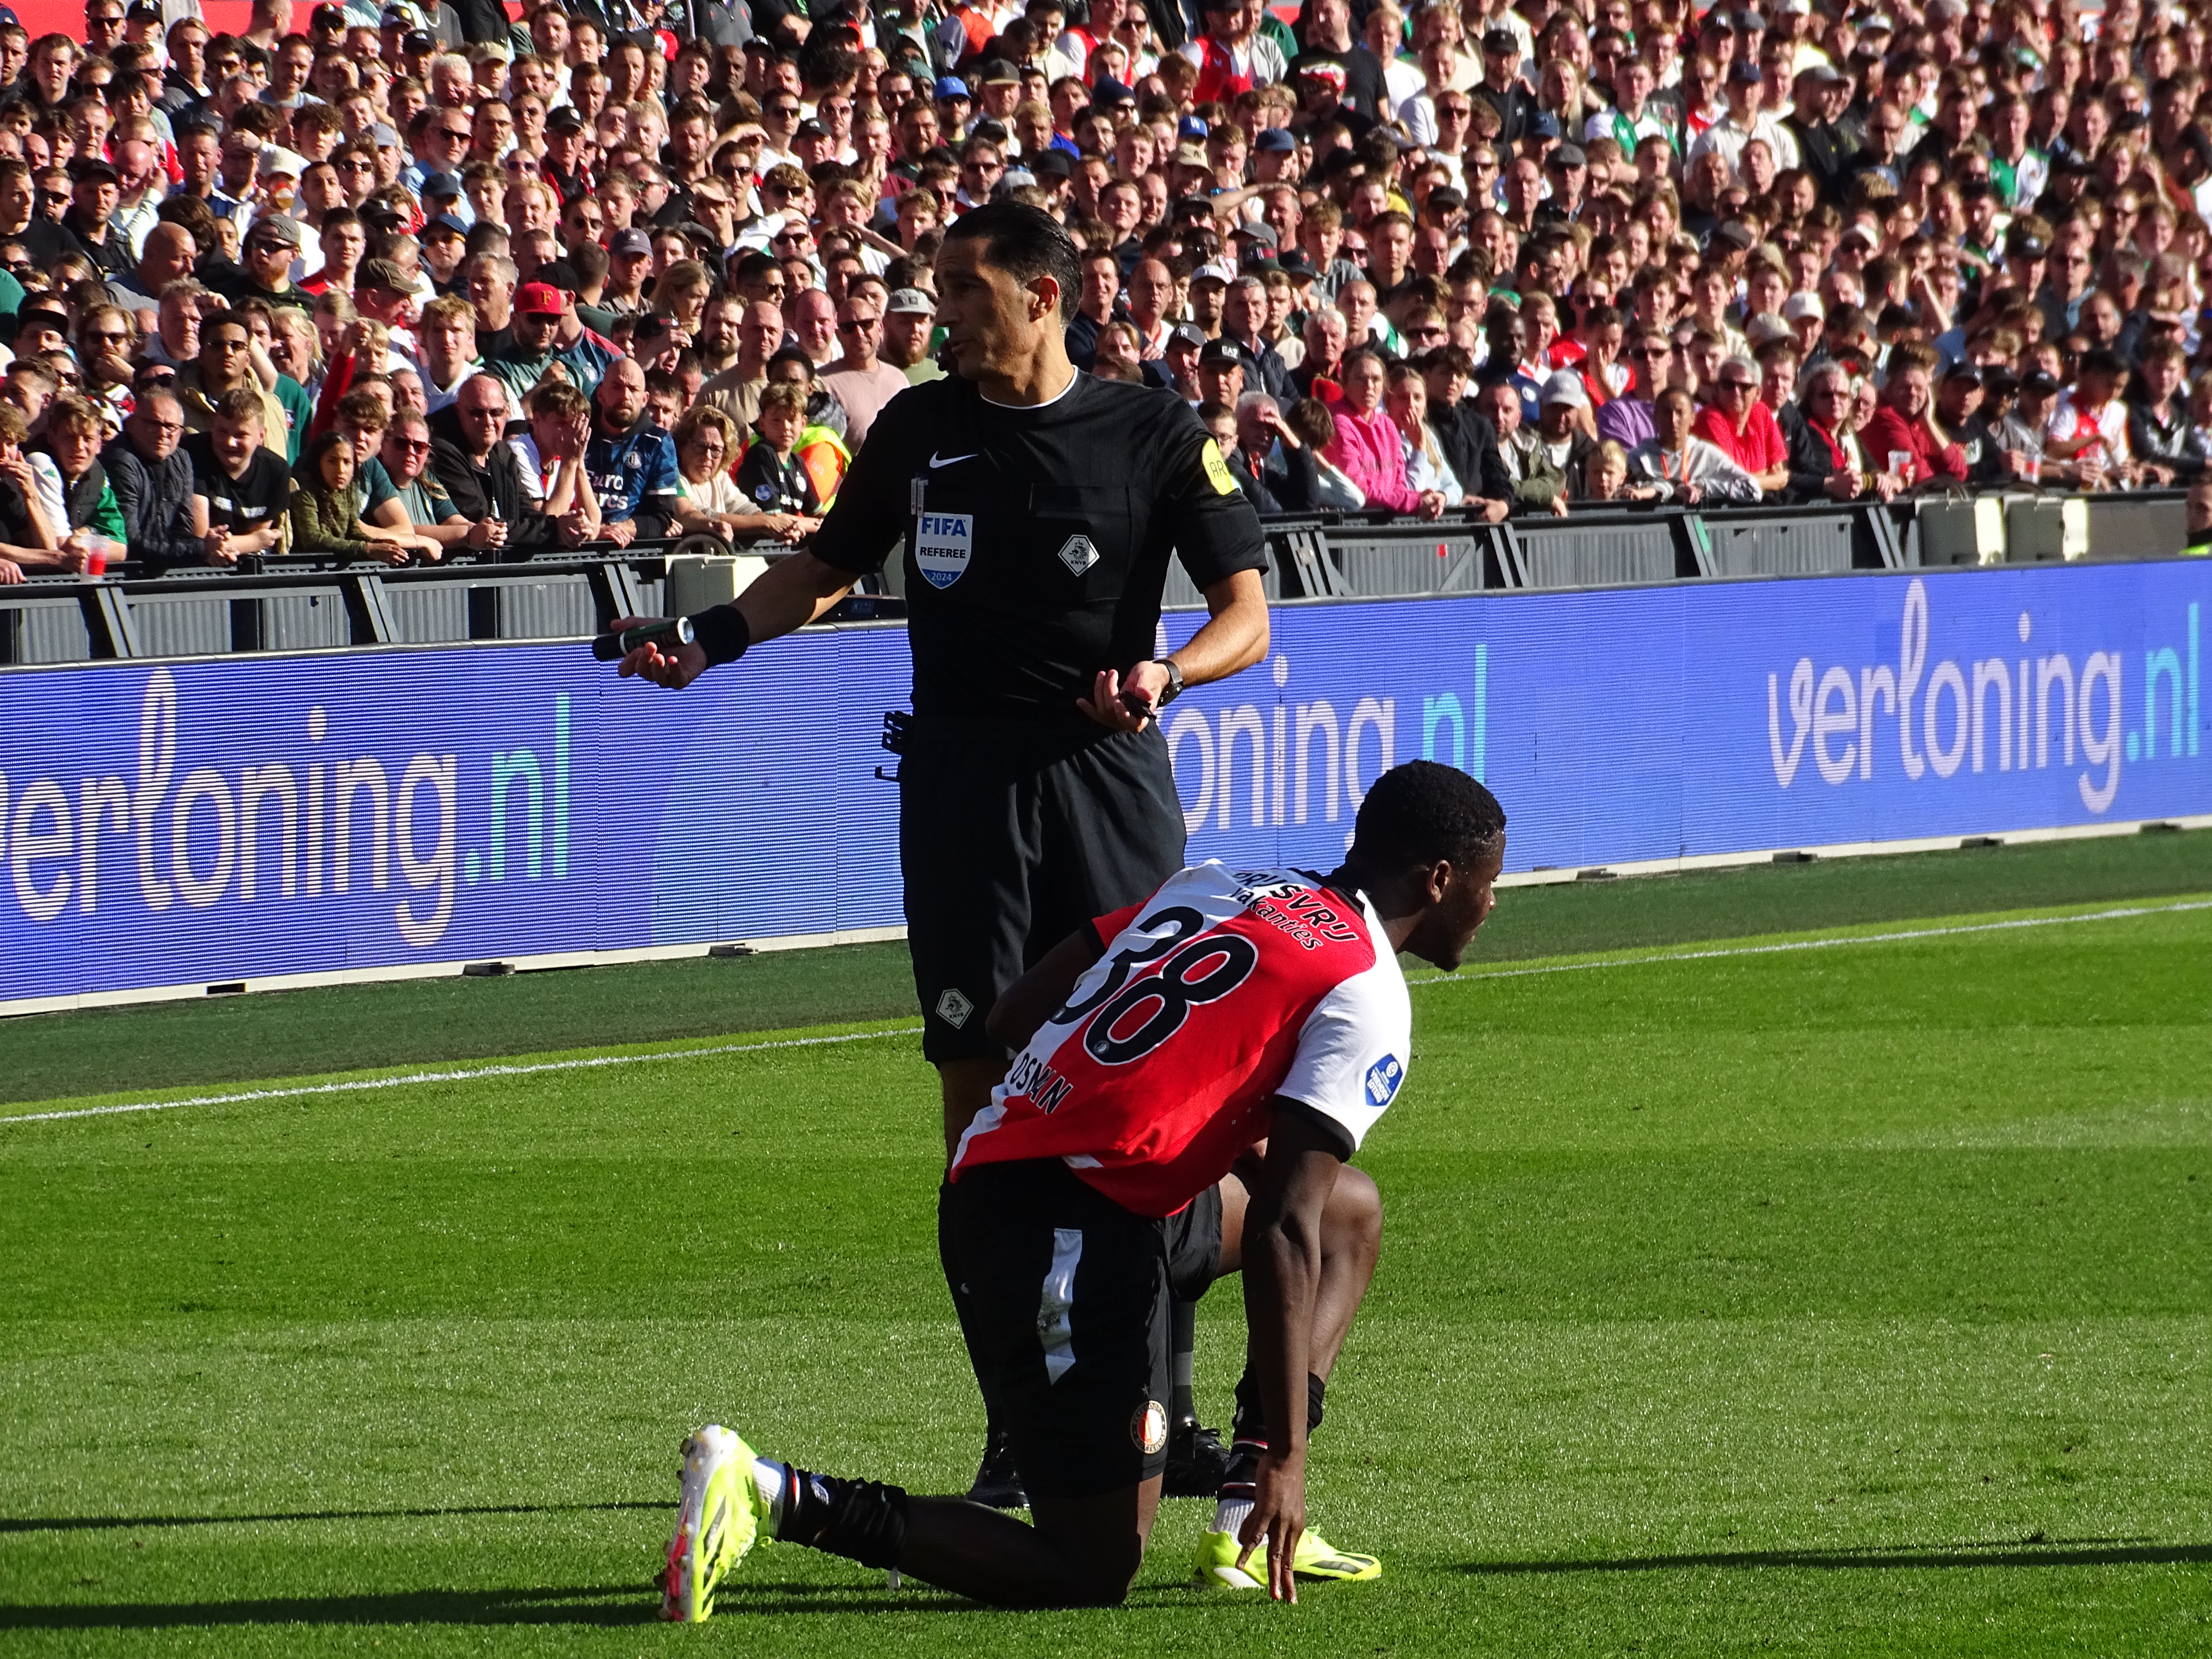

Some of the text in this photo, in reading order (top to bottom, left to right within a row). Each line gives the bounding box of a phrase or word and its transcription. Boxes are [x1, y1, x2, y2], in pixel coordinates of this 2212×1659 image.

[1210, 460, 1227, 478] AR
[922, 517, 967, 537] FIFA
[920, 547, 966, 559] REFEREE
[931, 572, 952, 582] 2024
[1768, 577, 2199, 813] verloning.nl
[1048, 905, 1259, 1065] 38
